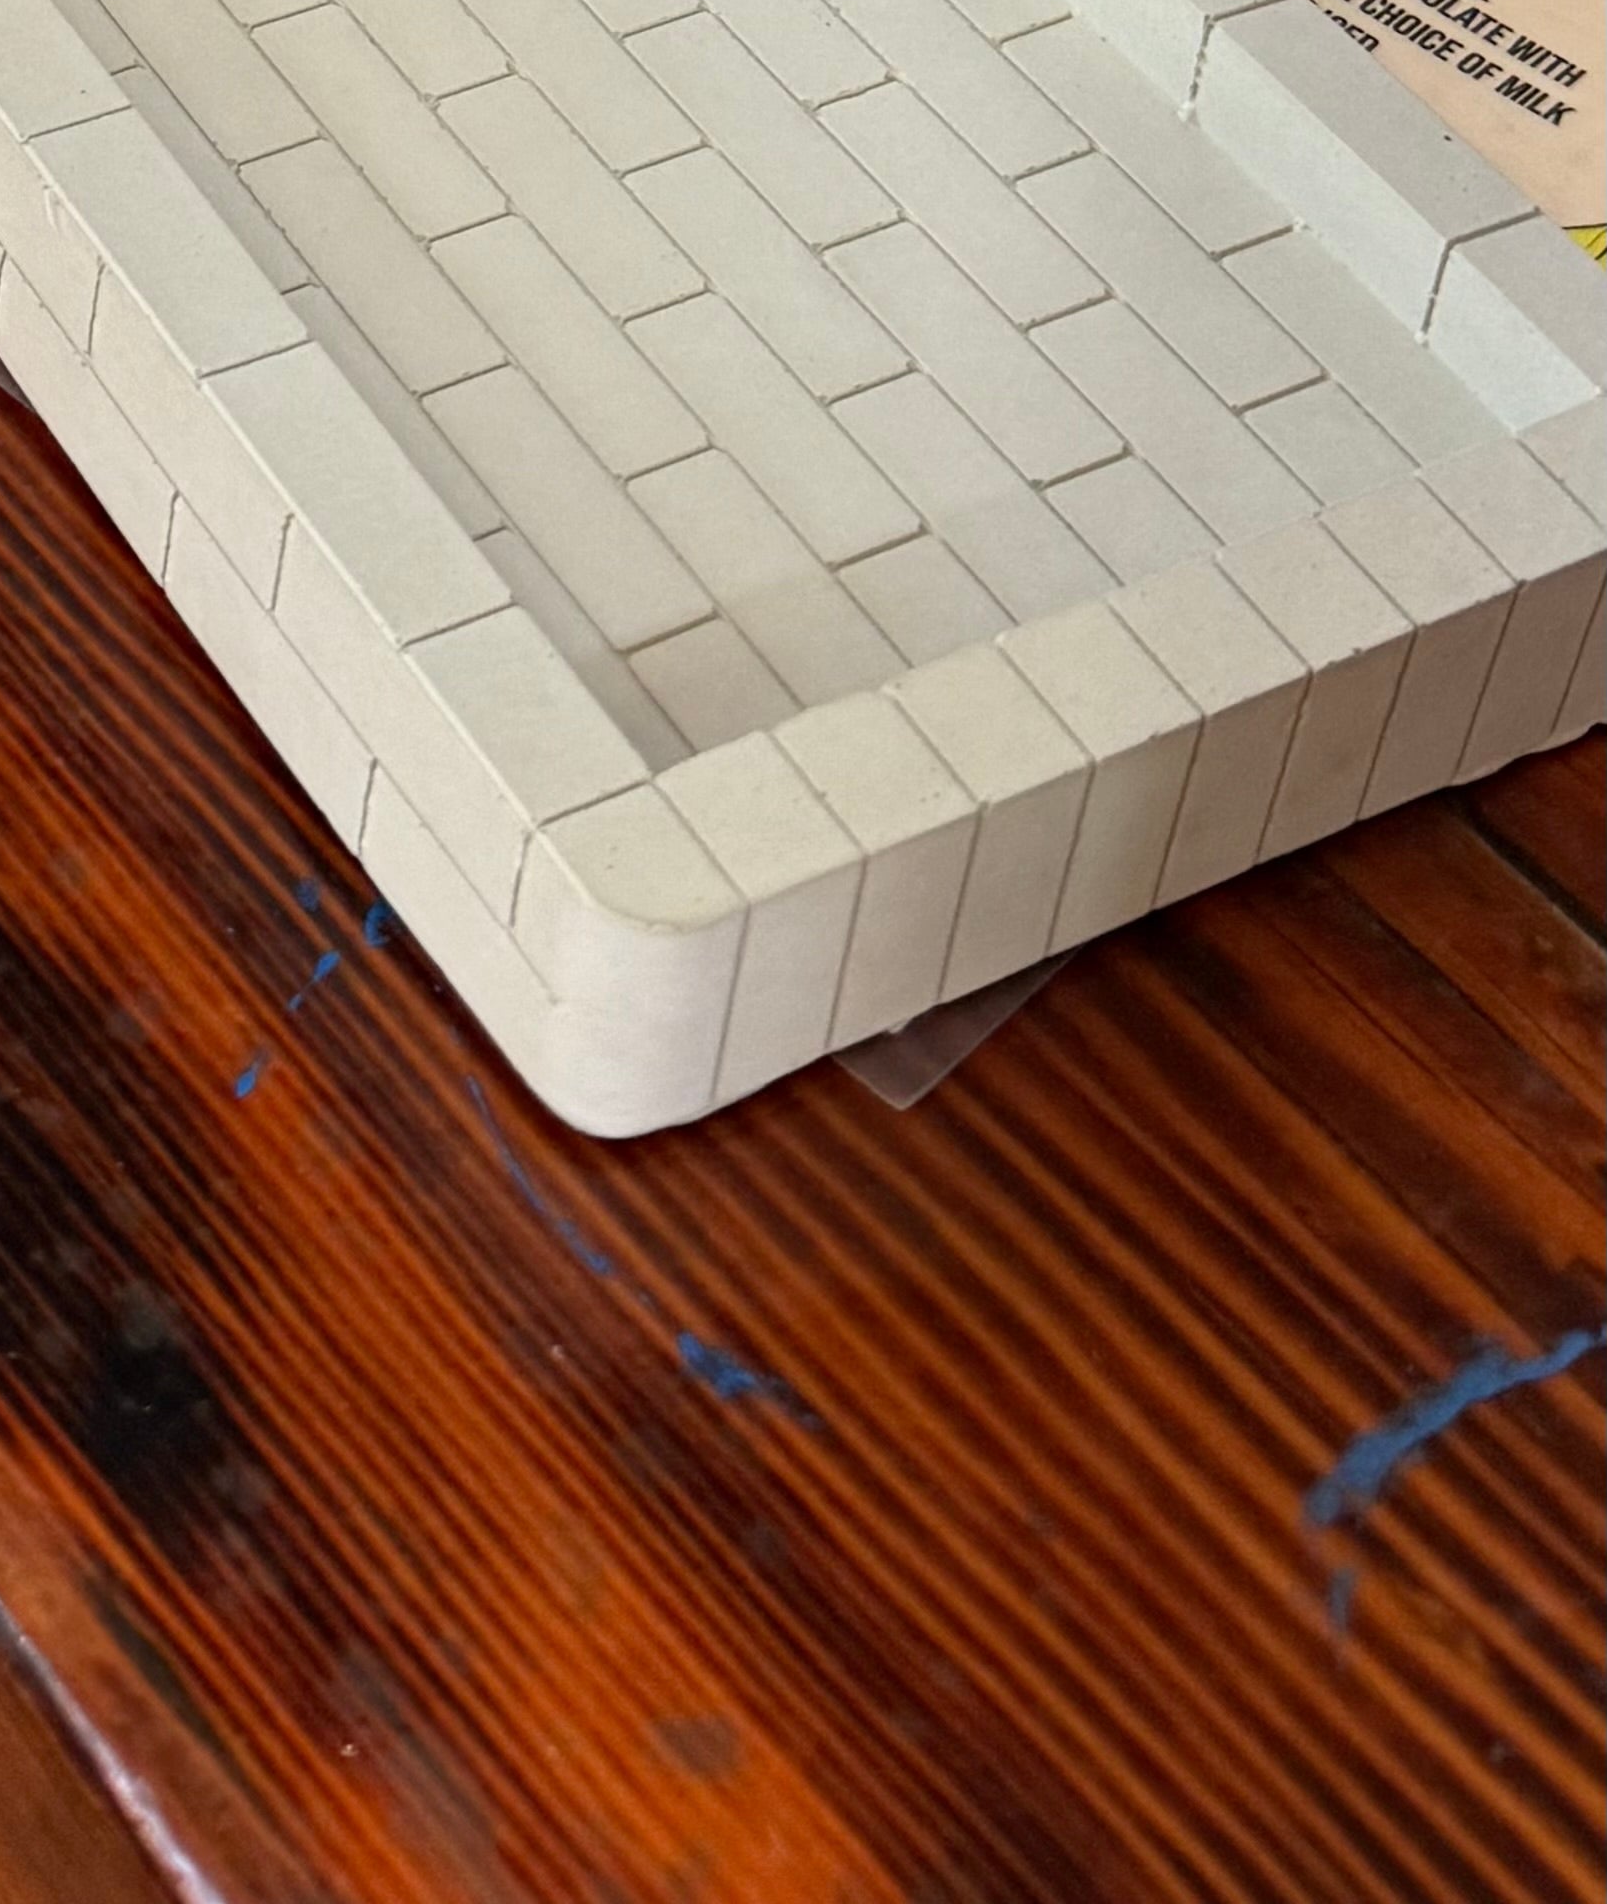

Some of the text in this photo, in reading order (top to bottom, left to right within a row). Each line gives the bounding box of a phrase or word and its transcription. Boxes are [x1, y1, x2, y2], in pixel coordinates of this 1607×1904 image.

[1456, 51, 1504, 81] OF
[1494, 74, 1578, 127] MILK
[1506, 34, 1587, 89] WITH
